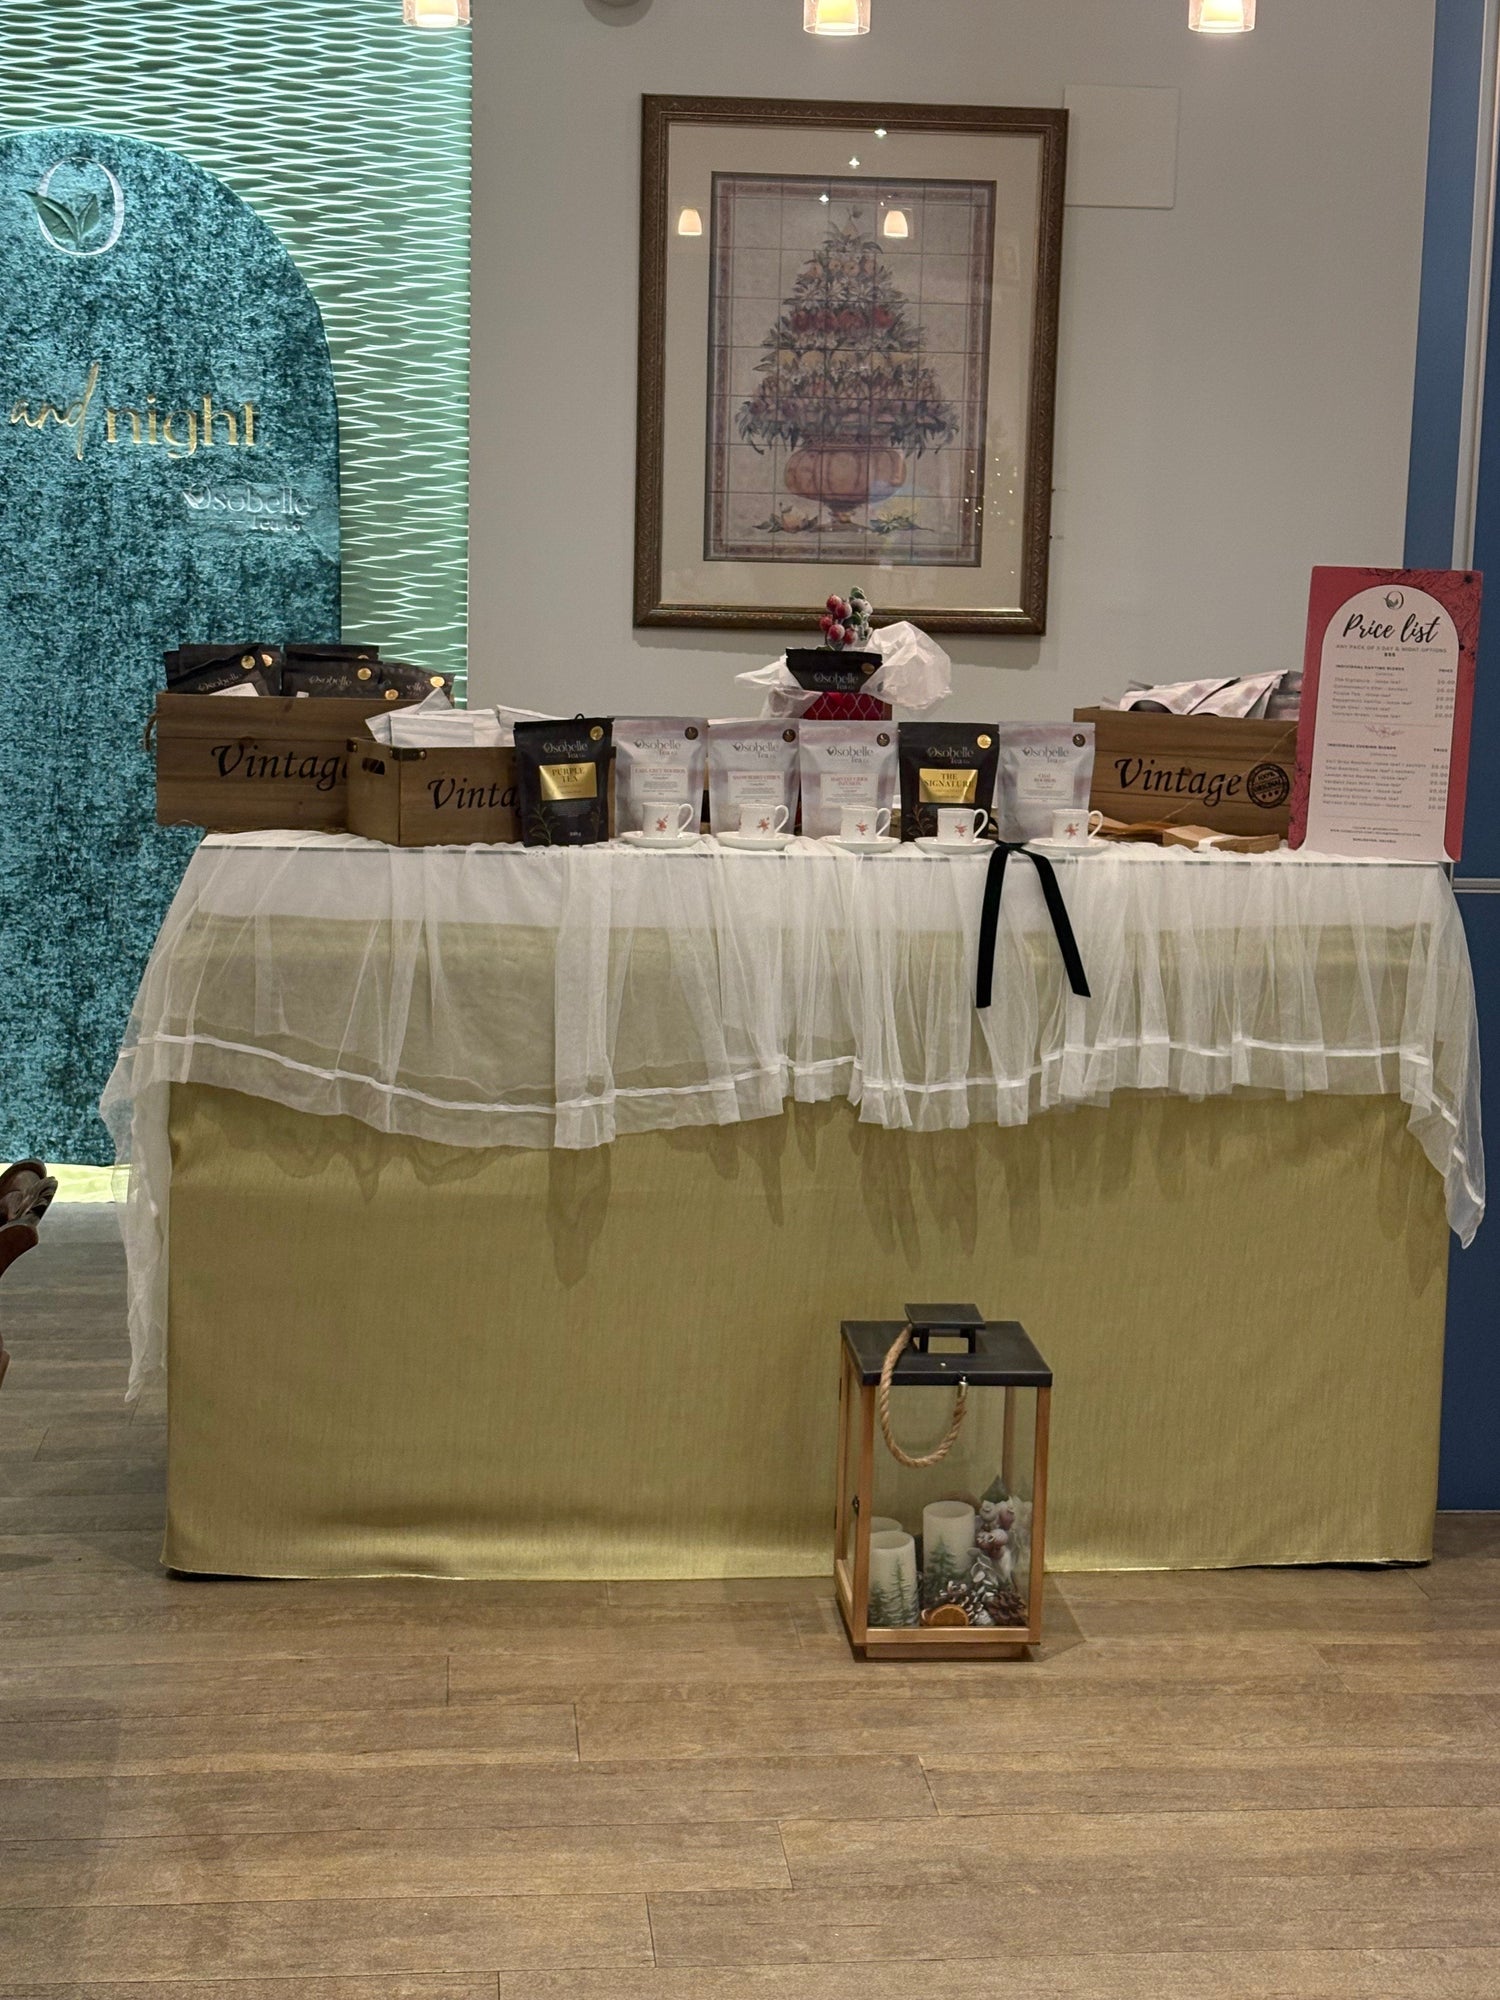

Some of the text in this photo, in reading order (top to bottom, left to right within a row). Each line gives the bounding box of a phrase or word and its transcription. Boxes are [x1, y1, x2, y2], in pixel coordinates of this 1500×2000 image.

[10, 361, 99, 460] and
[182, 483, 311, 516] Osobelle
[1342, 612, 1440, 643] Price list
[813, 672, 859, 684] Osobelle
[543, 740, 588, 753] Osobelle
[633, 738, 681, 750] Osobelle
[732, 741, 779, 752] Osobelle
[826, 746, 874, 757] Osobelle
[926, 746, 974, 758] Osobelle
[1022, 746, 1069, 757] Osobelle
[552, 767, 585, 777] PURPLE
[561, 775, 578, 784] TEA
[1114, 758, 1242, 807] Vintage
[427, 777, 520, 815] Vinta
